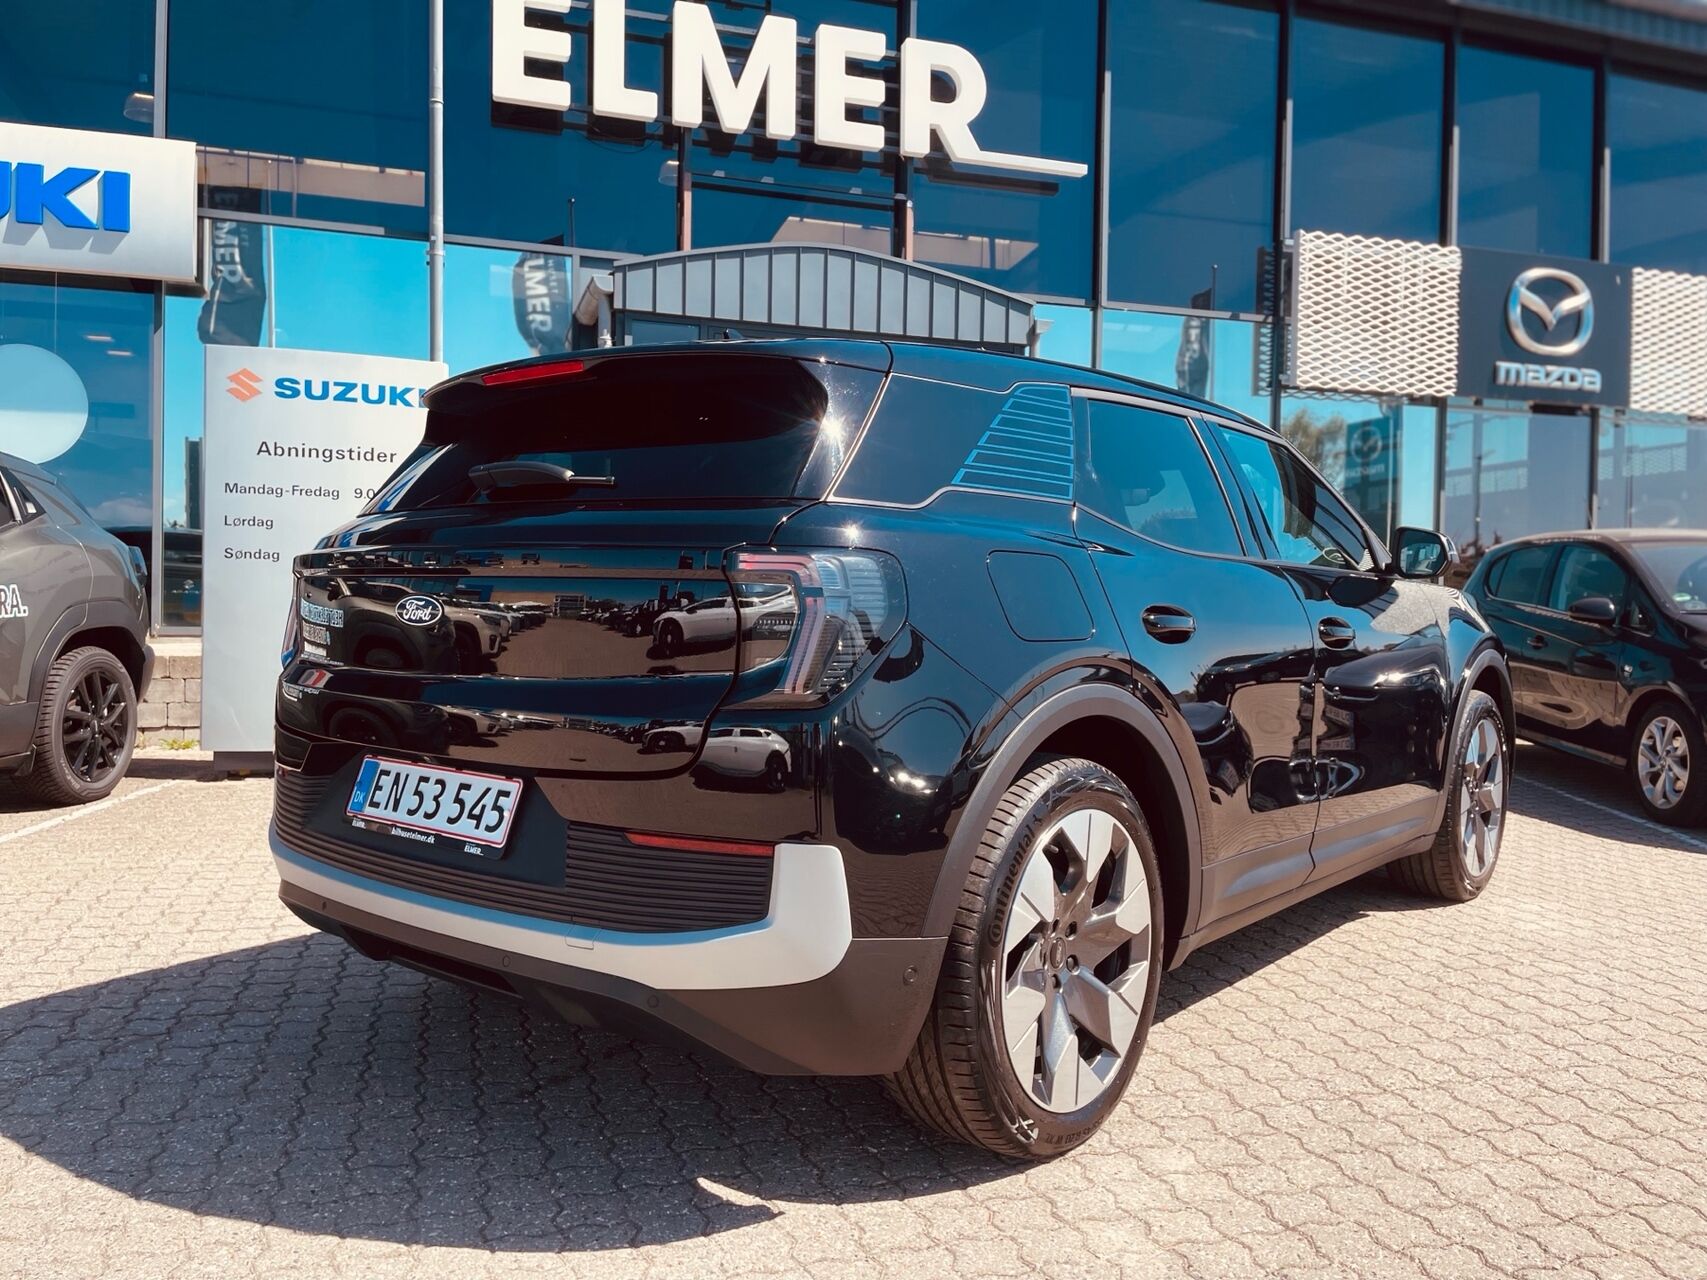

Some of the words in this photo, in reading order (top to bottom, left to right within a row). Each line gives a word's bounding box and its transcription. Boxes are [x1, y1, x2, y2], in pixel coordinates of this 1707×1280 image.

[492, 0, 1089, 178] ELMER
[1495, 361, 1602, 393] mazda
[256, 441, 397, 463] Abningstider
[224, 482, 340, 500] Mandag-Fredag
[224, 515, 274, 530] Lørdag
[224, 547, 281, 563] Søndag
[402, 599, 433, 621] Ford
[354, 791, 366, 803] DK
[368, 769, 410, 813] EN
[406, 775, 447, 820] 53
[446, 782, 511, 833] 545
